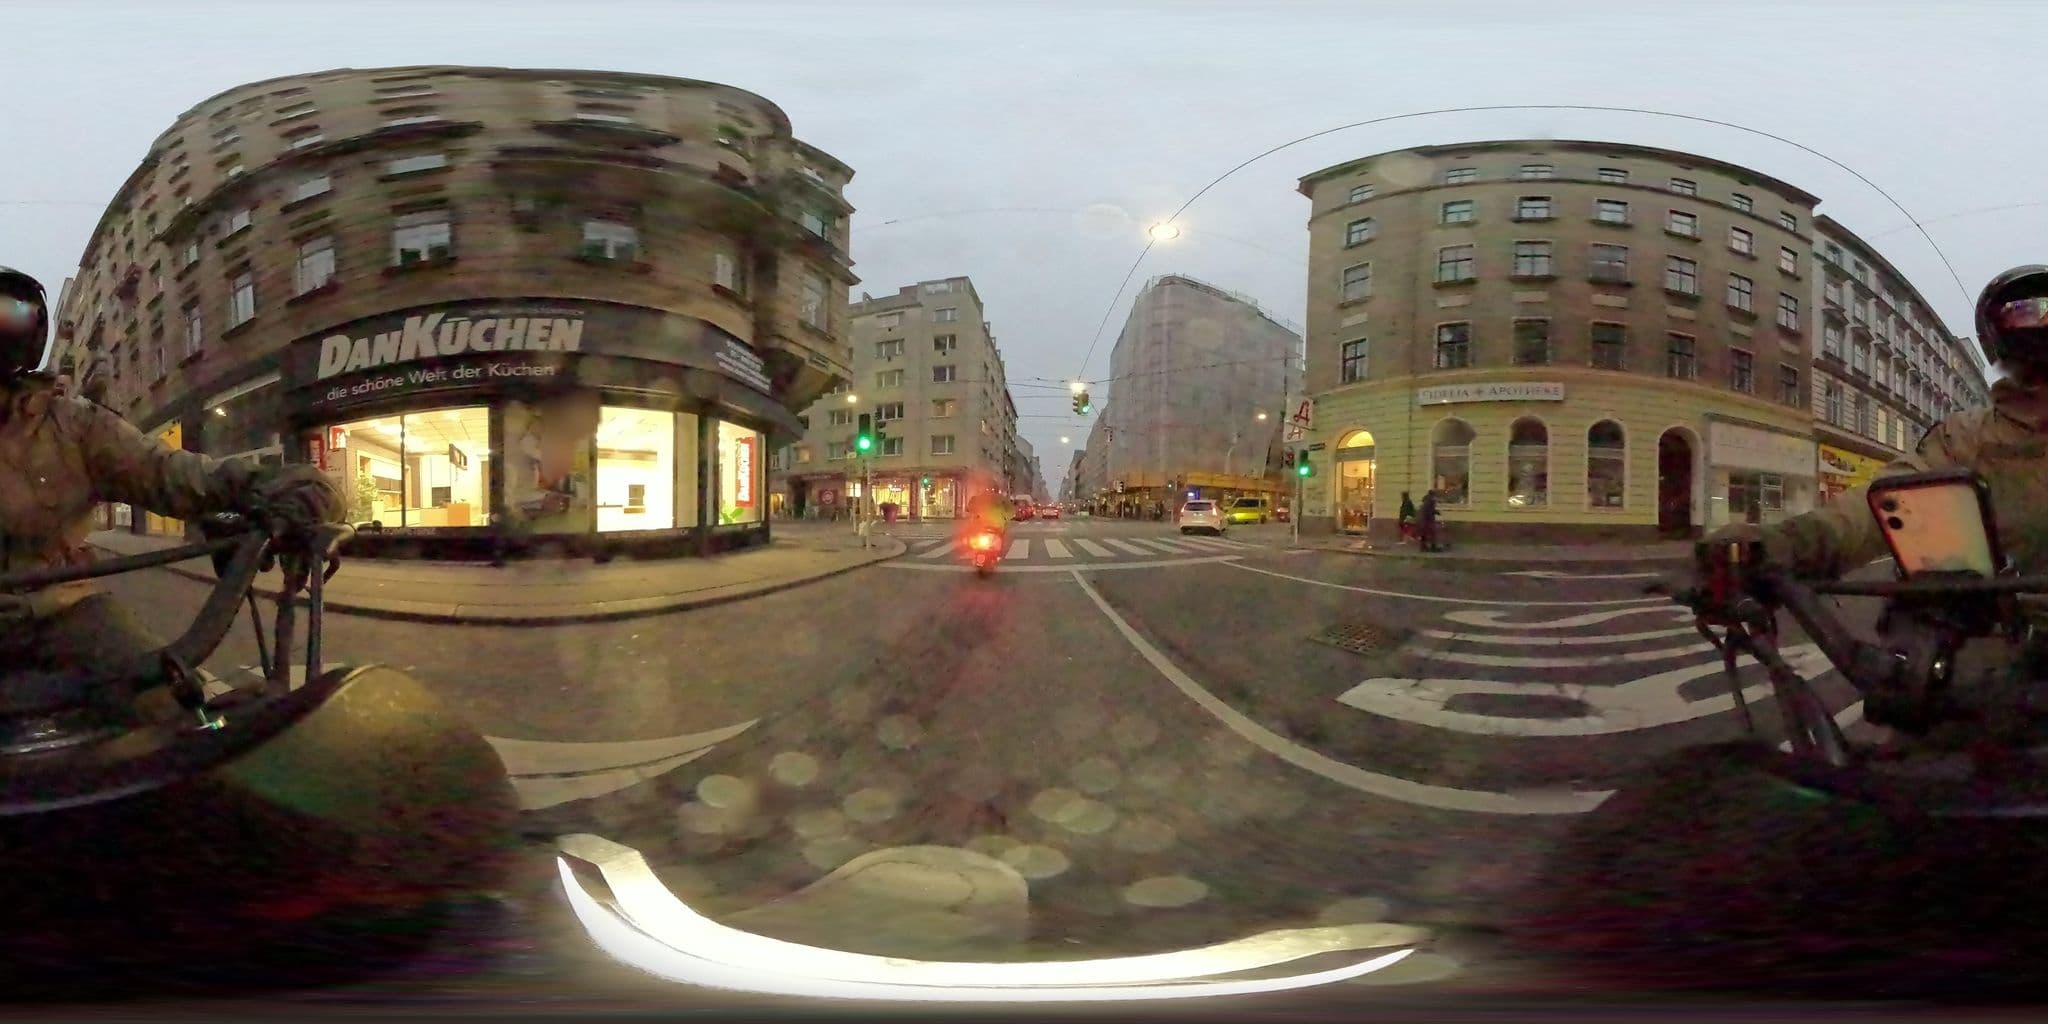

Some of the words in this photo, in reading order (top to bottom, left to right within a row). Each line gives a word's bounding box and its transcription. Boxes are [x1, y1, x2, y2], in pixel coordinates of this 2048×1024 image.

[326, 386, 348, 402] die
[351, 377, 404, 396] schöne
[452, 364, 483, 380] der
[488, 361, 555, 377] Küchen
